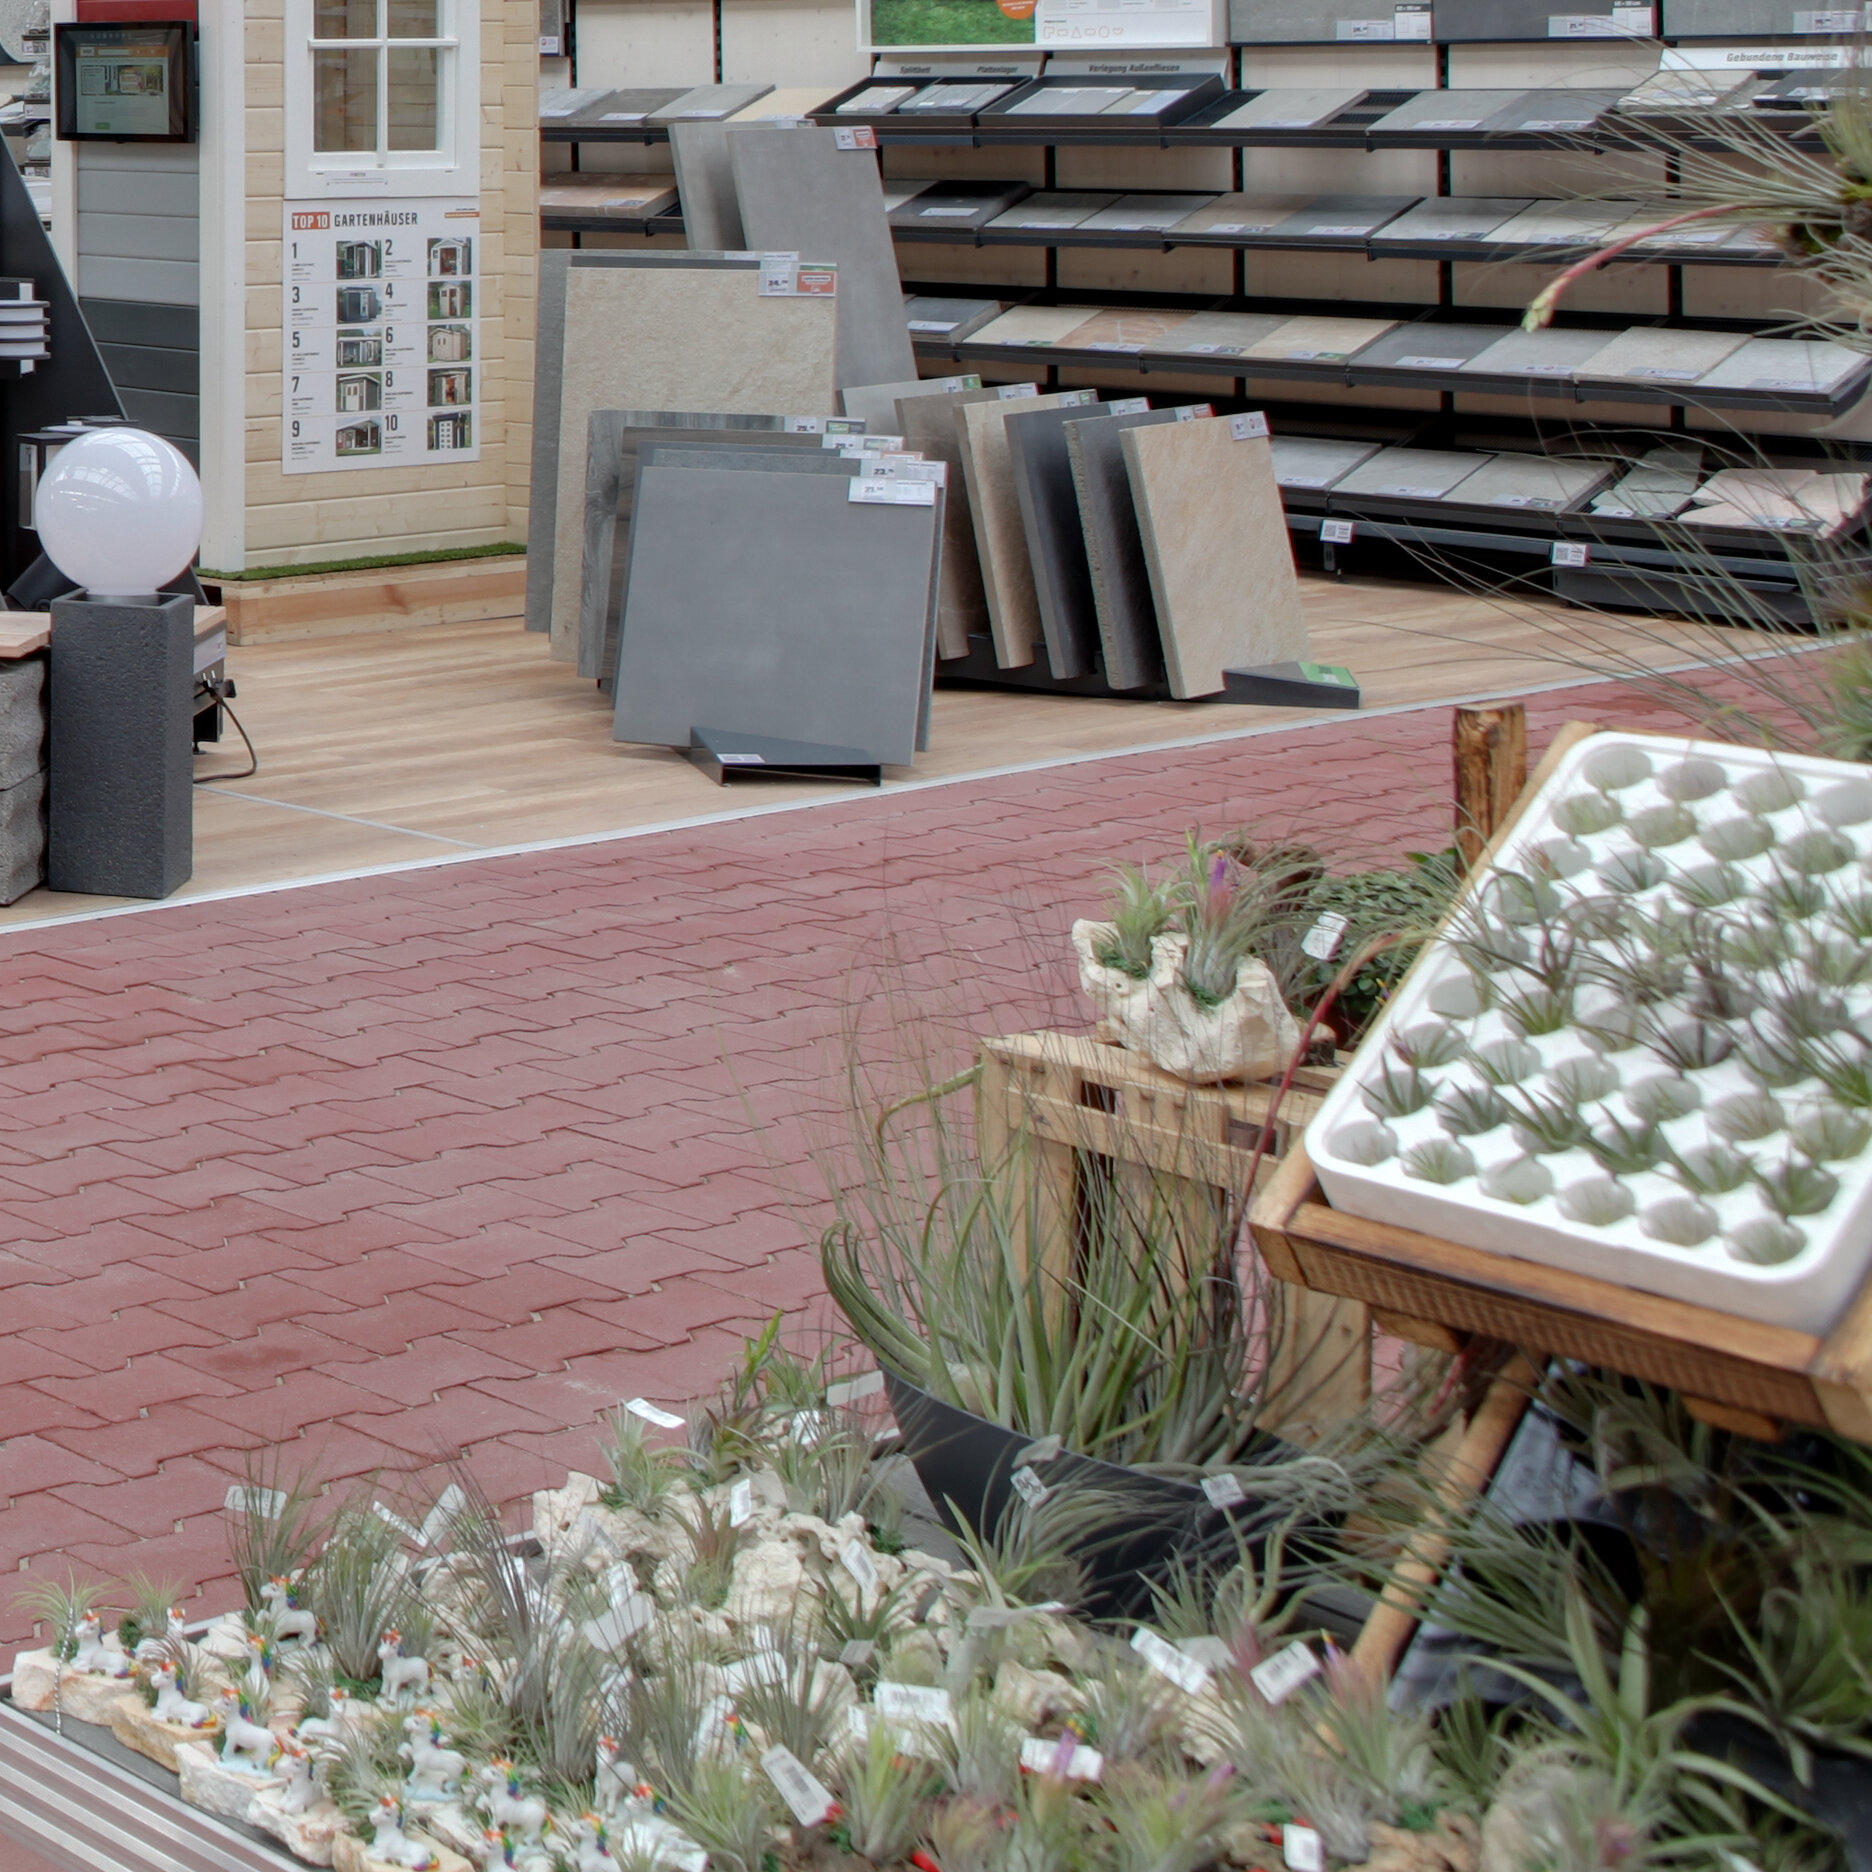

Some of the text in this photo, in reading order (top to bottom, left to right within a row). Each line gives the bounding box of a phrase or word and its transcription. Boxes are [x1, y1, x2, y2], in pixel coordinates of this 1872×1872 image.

[1726, 52, 1784, 62] Gebundene
[292, 211, 419, 229] TOP 10 GARTENHÄUSER
[292, 242, 297, 258] 1
[385, 239, 392, 256] 2
[292, 286, 300, 303] 3
[385, 283, 393, 299] 4
[292, 331, 300, 348] 5
[386, 327, 393, 343] 6
[292, 376, 299, 393] 7
[386, 371, 393, 387] 8
[292, 421, 300, 437] 9
[385, 414, 398, 431] 10
